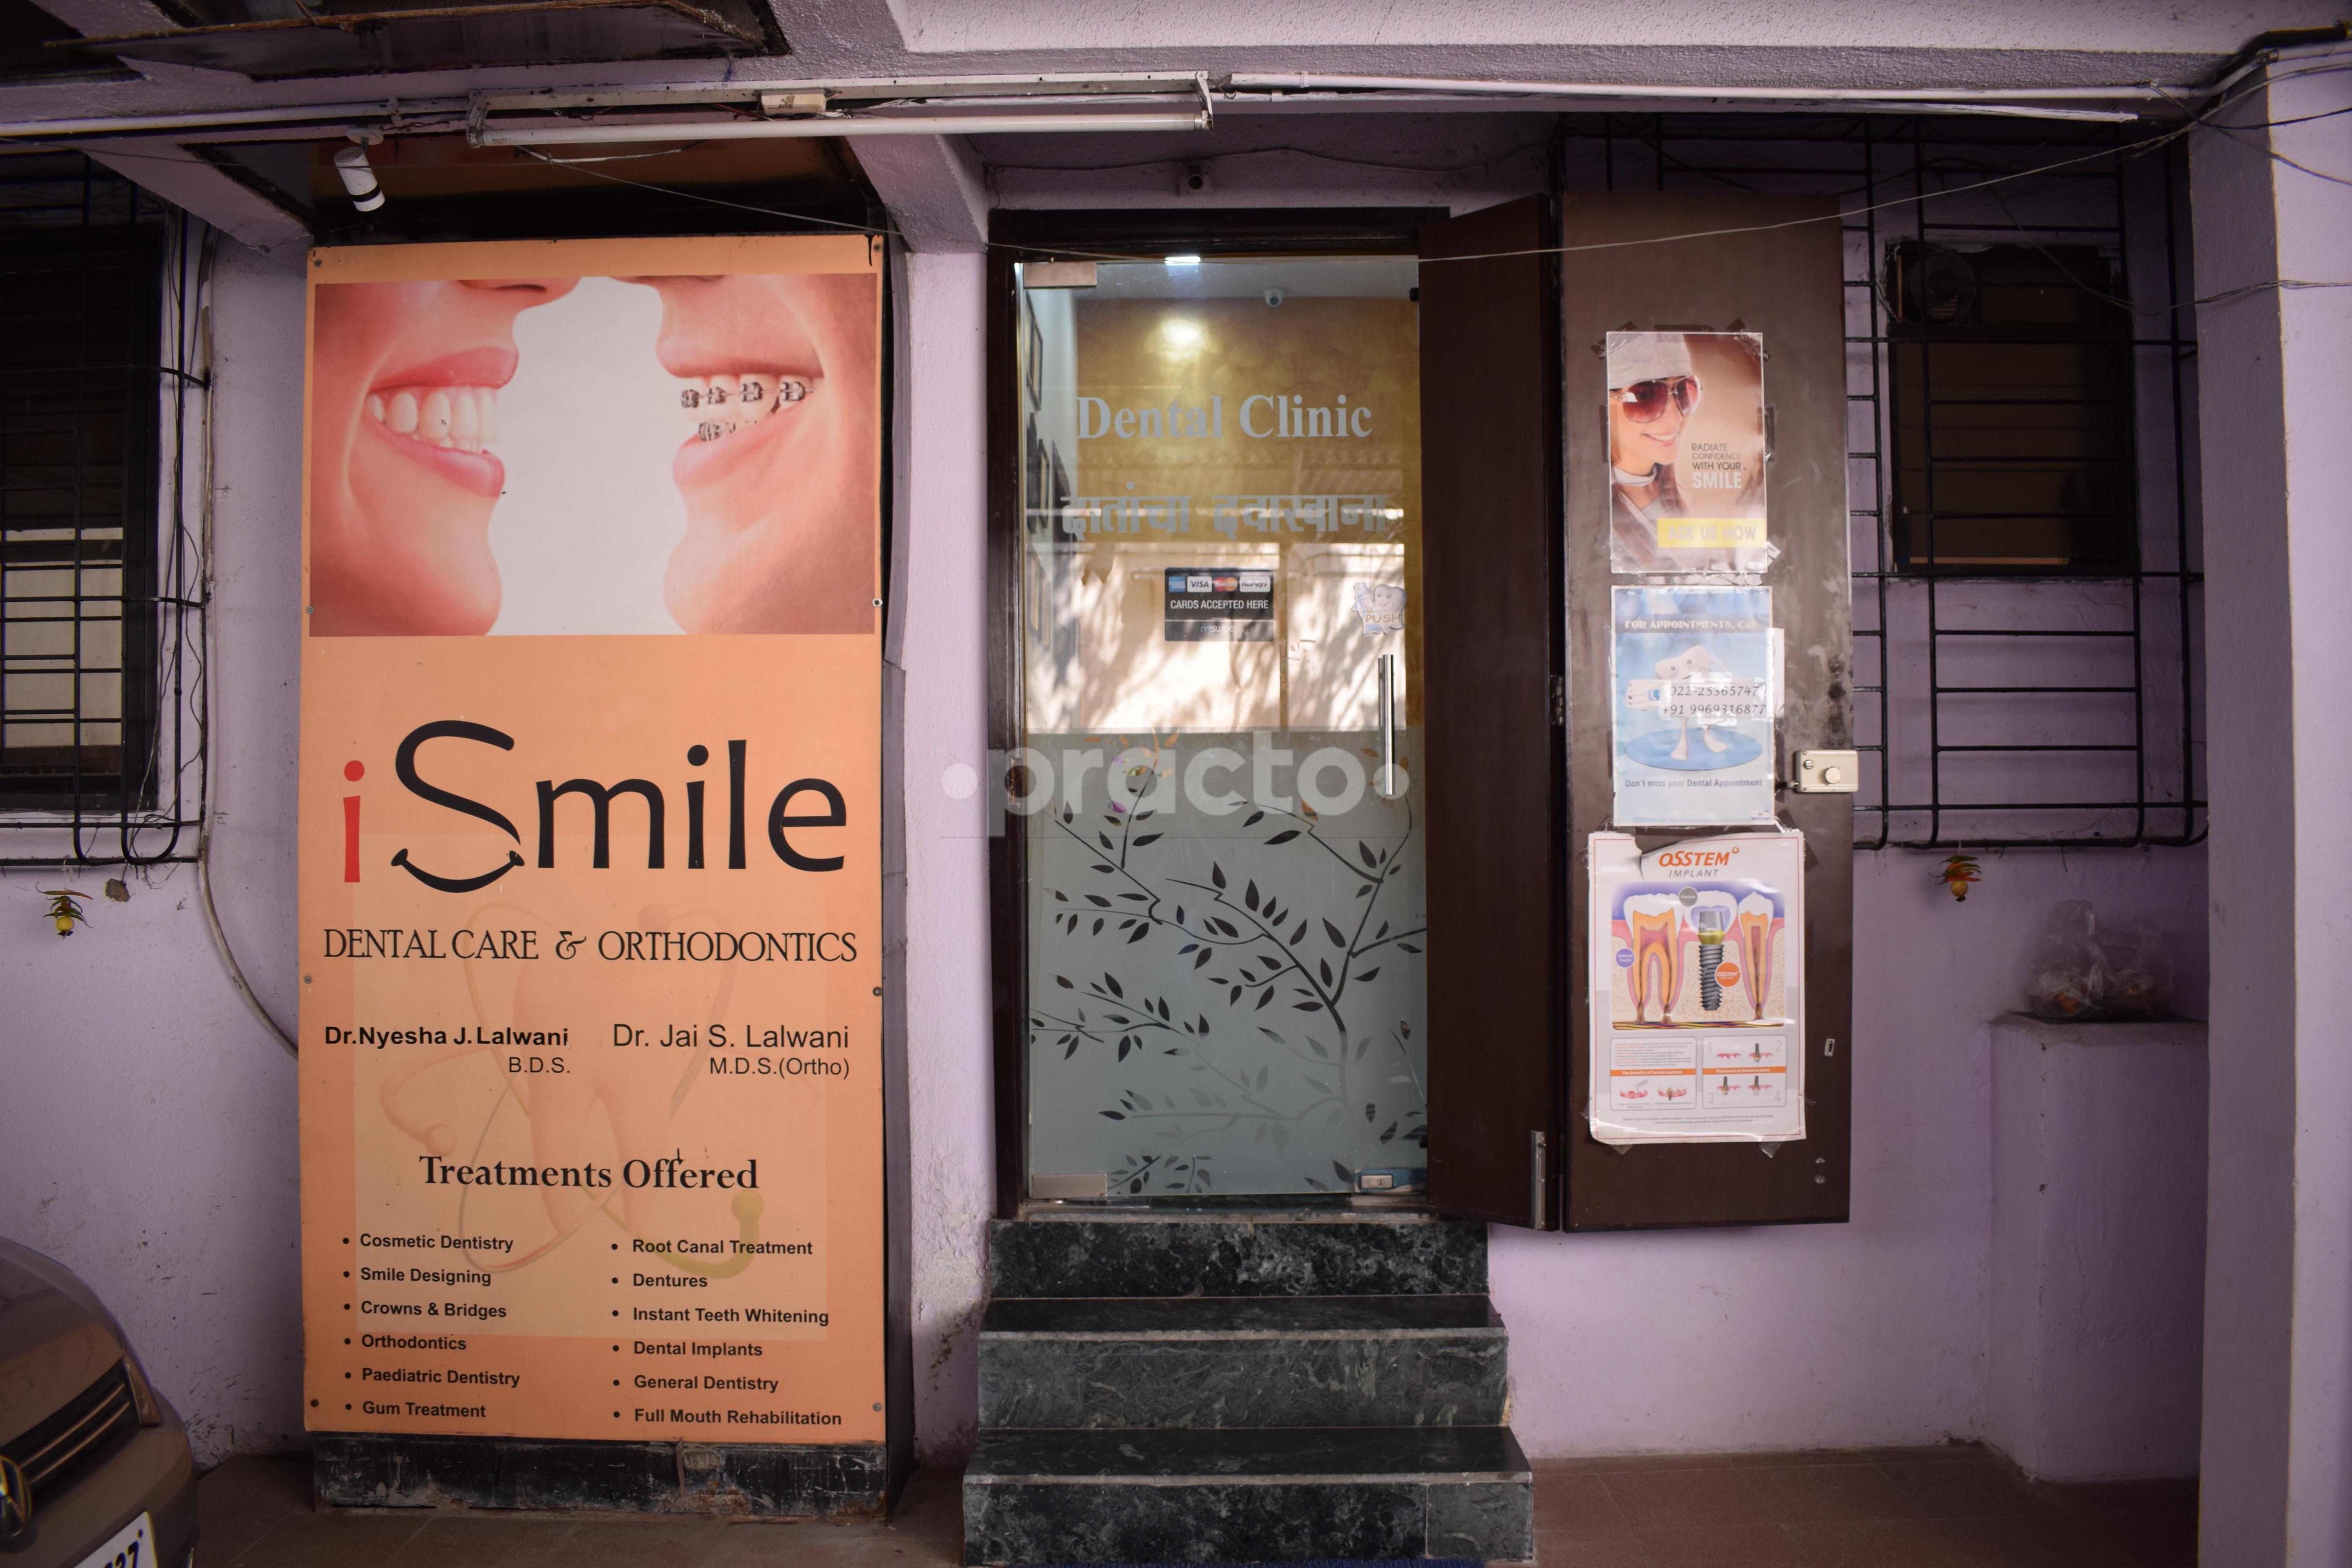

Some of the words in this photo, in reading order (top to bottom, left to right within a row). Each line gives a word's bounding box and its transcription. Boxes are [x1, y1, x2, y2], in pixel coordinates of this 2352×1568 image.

[1077, 394, 1223, 439] Dental
[1240, 394, 1372, 439] Clinic
[1693, 461, 1713, 470] WITH
[1717, 462, 1741, 470] YOUR
[1692, 472, 1742, 489] SMILE
[1061, 482, 1191, 540] दातांचा
[1212, 495, 1388, 539] दवाखाना
[1668, 526, 1694, 540] ASK
[1700, 526, 1717, 540] US
[1723, 526, 1757, 540] HOW
[1170, 600, 1199, 609] CARDS
[1201, 600, 1244, 609] ACCEPTED
[1246, 600, 1269, 609] HERE
[1366, 613, 1401, 623] PUSH
[1664, 705, 1684, 715] +91
[1668, 780, 1685, 788] your
[1715, 779, 1762, 788] Appointment
[324, 929, 446, 959] DENTAL
[452, 930, 539, 960] CARE
[556, 931, 586, 960] &
[598, 931, 857, 962] ORTHODONTICS
[325, 1026, 446, 1049] Dr.Nyesha
[454, 1027, 472, 1045] J.
[477, 1026, 568, 1046] Lalwani
[614, 1024, 649, 1047] Dr.
[660, 1024, 697, 1047] Jai
[708, 1024, 734, 1047] S.
[747, 1025, 848, 1048] Lalwani
[1776, 1040, 1782, 1051] 2
[509, 1057, 570, 1073] B.D.S.
[710, 1057, 849, 1076] M.D.S.(Ortho)
[1708, 1093, 1714, 1104] 3
[1775, 1091, 1780, 1101] 4
[419, 1156, 612, 1189] Treatments
[623, 1157, 759, 1189] Offered
[360, 1233, 436, 1248] Cosmetic
[441, 1235, 514, 1254] Dentistry
[633, 1239, 672, 1253] Root
[677, 1239, 724, 1254] Canal
[729, 1240, 813, 1255] Treatment
[361, 1267, 405, 1281] Smile
[410, 1268, 491, 1287] Designing
[633, 1273, 708, 1288] Dentures
[361, 1300, 422, 1316] Crowns
[427, 1302, 439, 1316] &
[444, 1303, 507, 1320] Bridges
[633, 1307, 690, 1321] Instant
[695, 1308, 740, 1322] Teeth
[745, 1308, 829, 1327] Whitening
[361, 1334, 466, 1350] Orthodontics
[634, 1341, 686, 1355] Dental
[692, 1342, 763, 1360] Implants
[362, 1367, 442, 1383] Paediatric
[447, 1370, 520, 1388] Dentistry
[634, 1374, 698, 1389] General
[704, 1376, 779, 1394] Dentistry
[363, 1401, 400, 1415] Gum
[405, 1402, 486, 1418] Treatment
[635, 1408, 664, 1422] Full
[670, 1409, 721, 1423] Mouth
[727, 1410, 842, 1425] Rehabilitation
